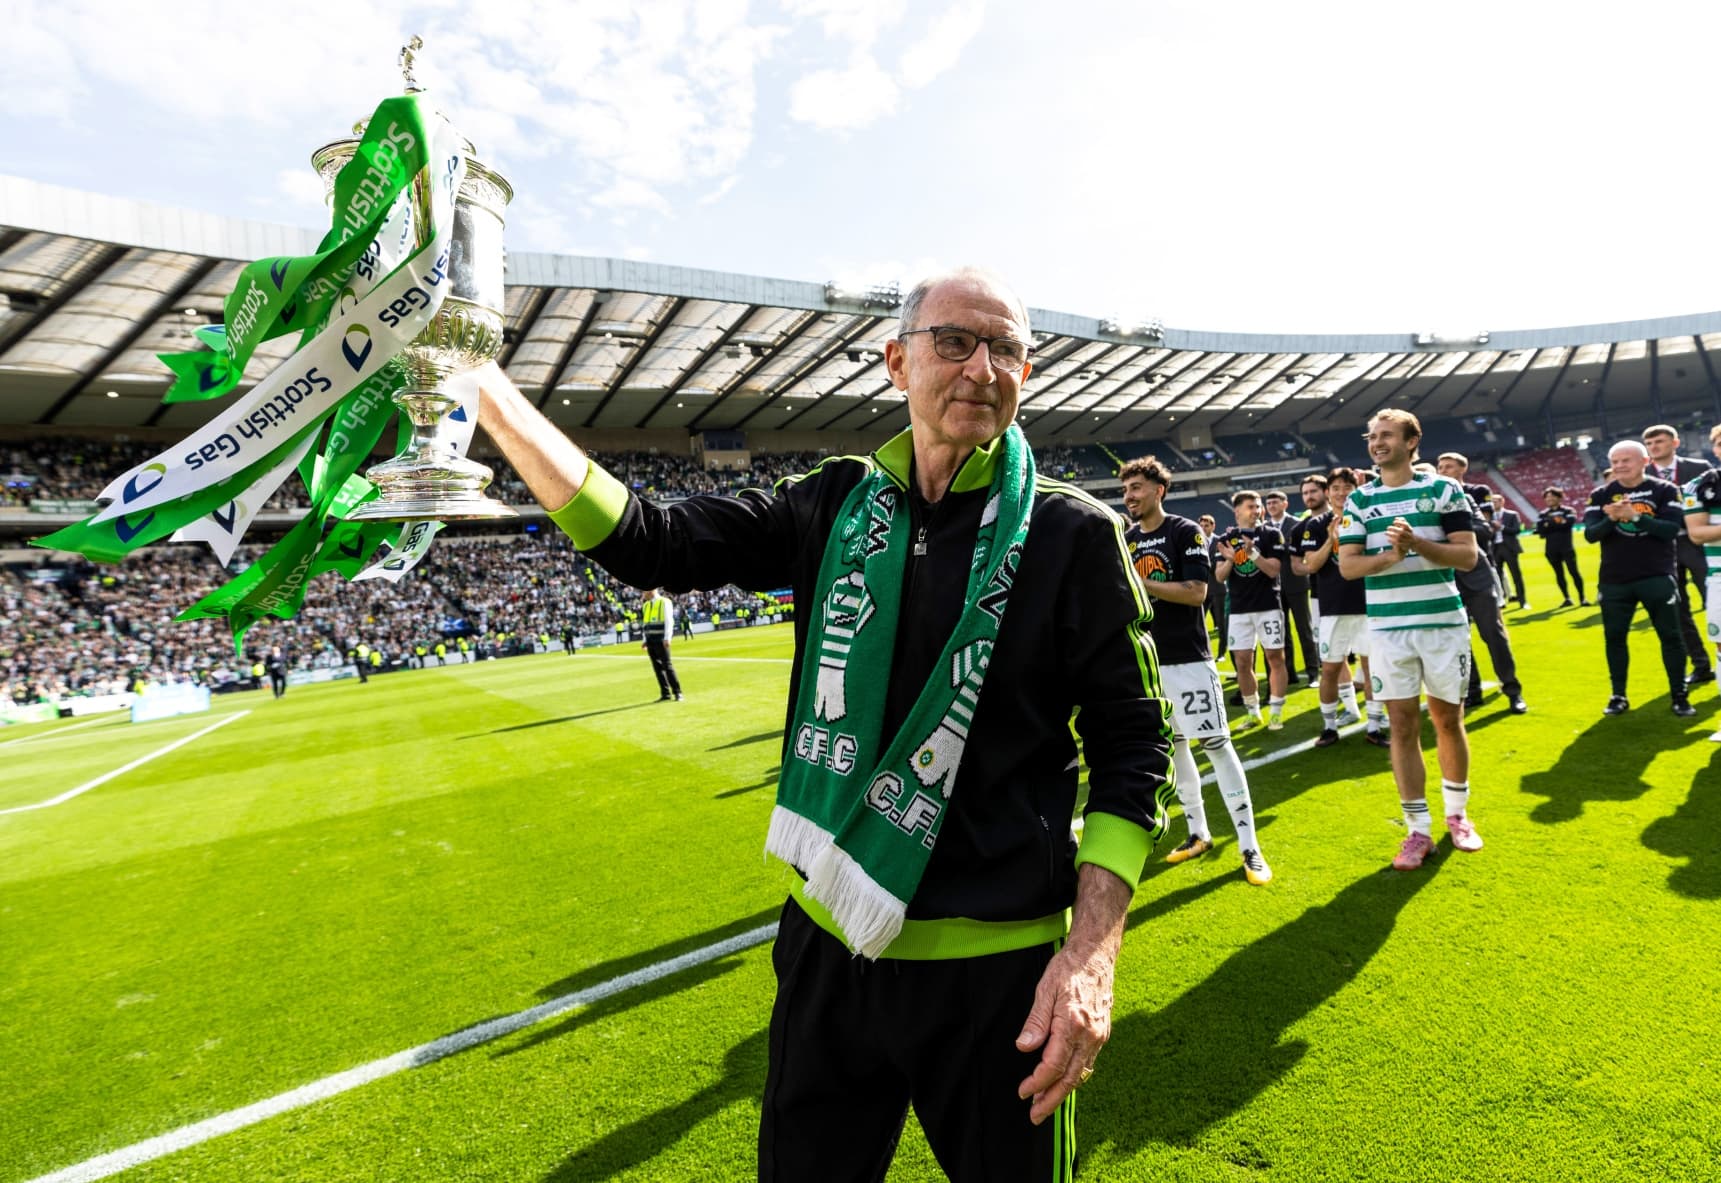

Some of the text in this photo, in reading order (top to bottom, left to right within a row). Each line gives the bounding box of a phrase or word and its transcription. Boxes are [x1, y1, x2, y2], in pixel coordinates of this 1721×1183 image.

[344, 121, 416, 229] Scottish
[229, 279, 269, 345] Scottish
[378, 286, 432, 329] Gas
[184, 367, 333, 471] Scottish Gas
[402, 522, 430, 553] Gas
[1263, 620, 1281, 635] 63
[1459, 654, 1467, 678] 8
[1181, 690, 1213, 716] 23
